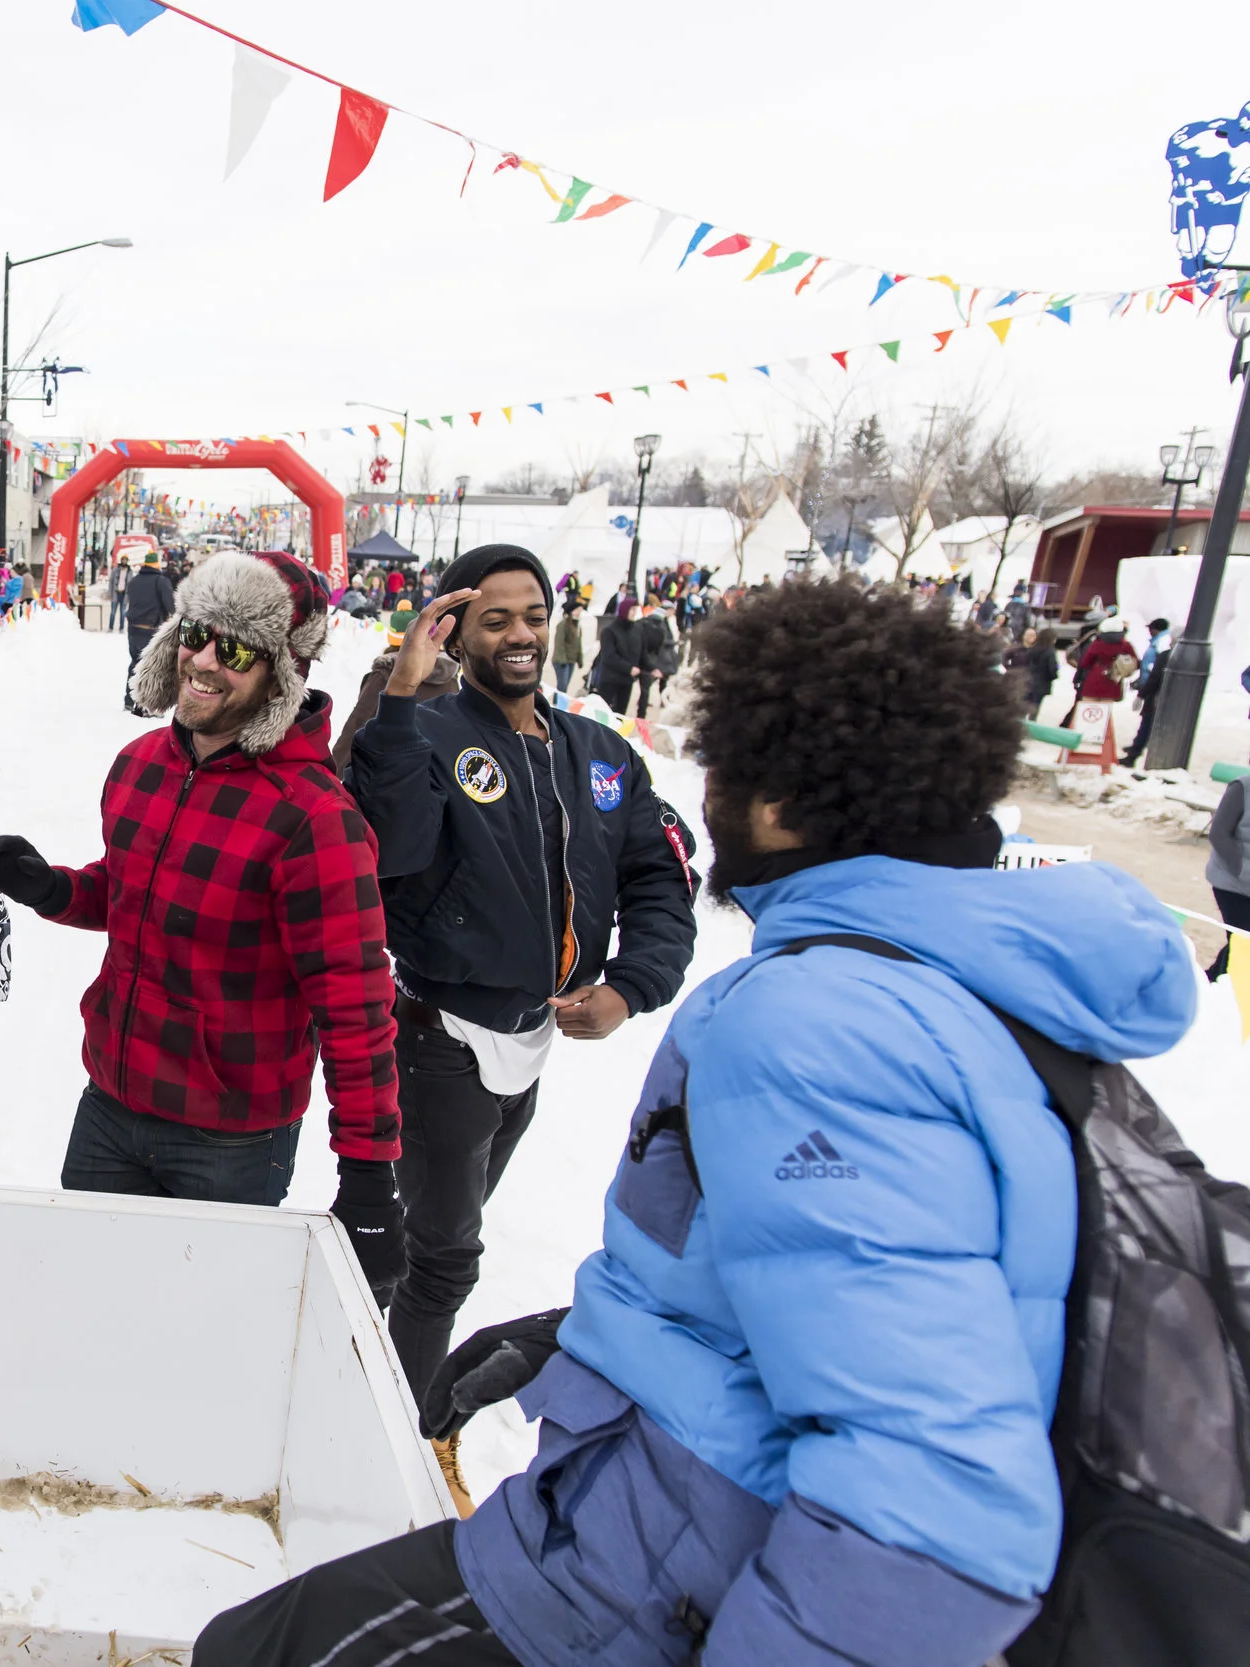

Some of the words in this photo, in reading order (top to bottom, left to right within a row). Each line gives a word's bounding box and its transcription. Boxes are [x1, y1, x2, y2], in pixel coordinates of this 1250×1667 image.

[48, 532, 64, 567] Cycle
[774, 1161, 861, 1181] adidas
[356, 1226, 385, 1234] HEAD
